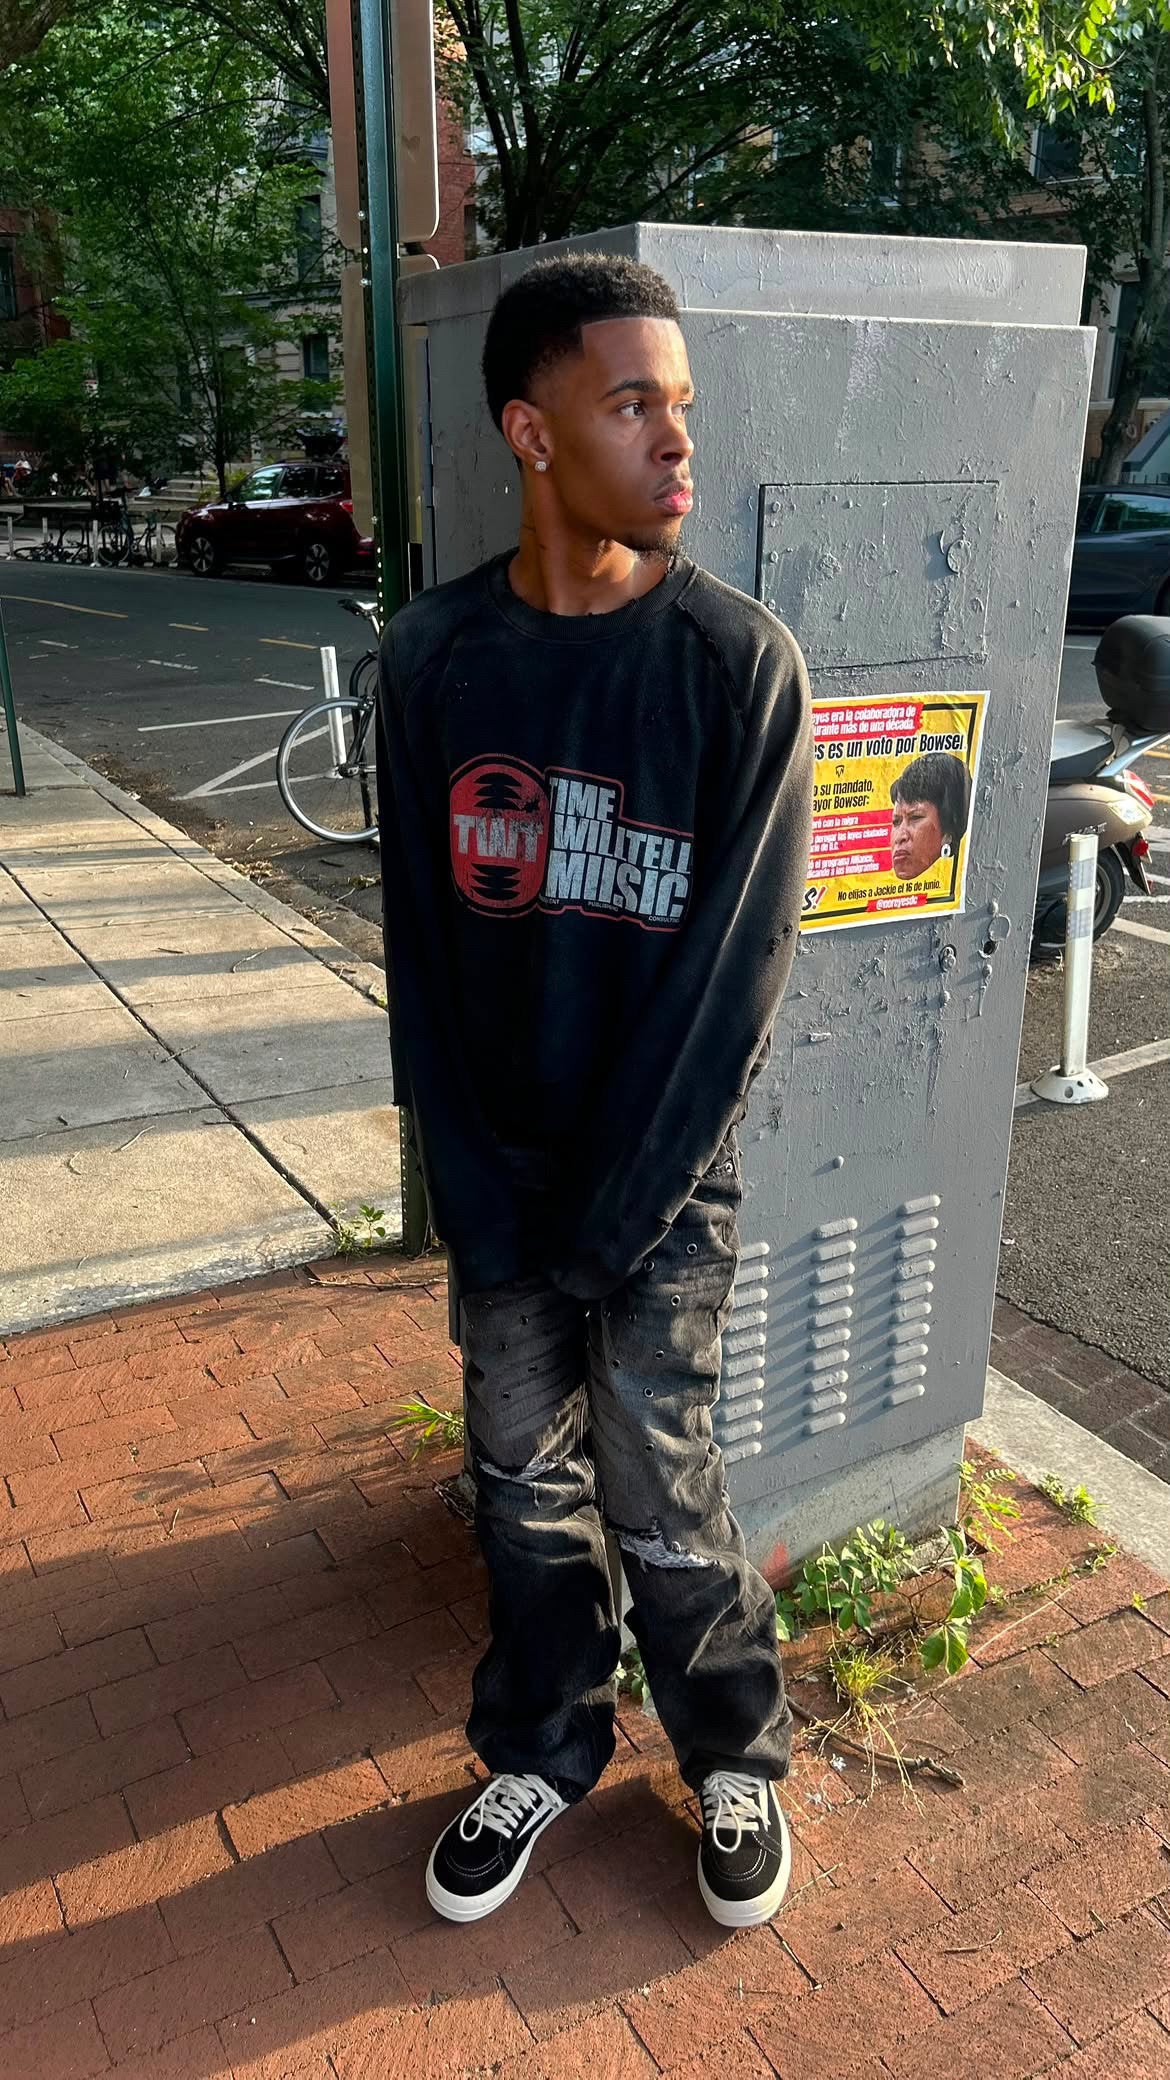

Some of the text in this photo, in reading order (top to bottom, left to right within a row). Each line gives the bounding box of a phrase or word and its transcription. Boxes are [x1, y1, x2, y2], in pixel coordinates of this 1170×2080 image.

[831, 711, 844, 722] era
[846, 709, 853, 721] la
[854, 707, 905, 721] colaboradora
[905, 706, 916, 718] de
[840, 721, 857, 734] más
[859, 721, 869, 733] de
[870, 721, 885, 732] una
[828, 742, 843, 759] es
[847, 740, 863, 758] un
[866, 736, 893, 756] voto
[895, 735, 917, 757] por
[820, 783, 831, 796] su
[833, 778, 874, 795] mandato,
[549, 776, 617, 824] TIME
[833, 795, 870, 810] Bowser:
[453, 813, 543, 863] TWT
[553, 812, 691, 875] WILL TELL
[545, 848, 690, 918] MUSIC
[838, 890, 847, 902] No
[848, 888, 867, 901] elijas
[868, 889, 873, 897] a
[874, 884, 896, 897] Jackie
[897, 883, 905, 893] el
[905, 881, 912, 893] 16
[913, 881, 922, 892] de
